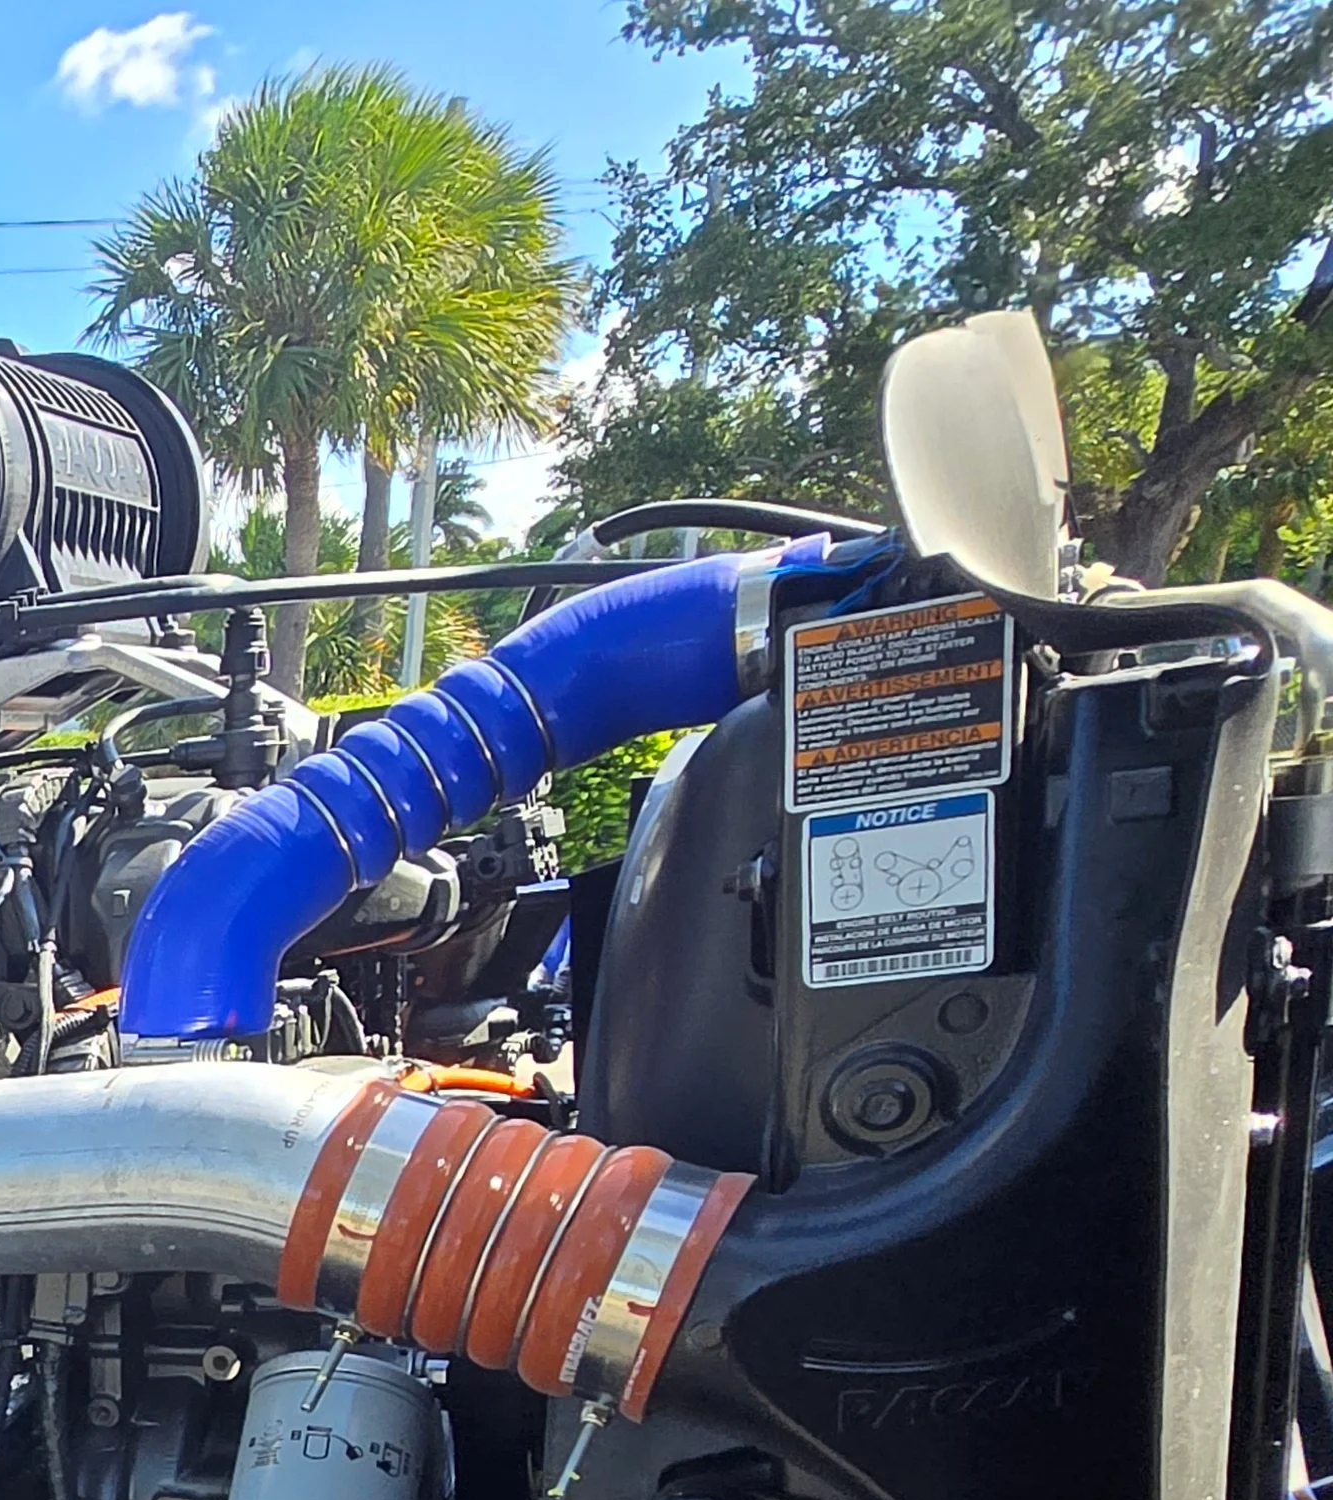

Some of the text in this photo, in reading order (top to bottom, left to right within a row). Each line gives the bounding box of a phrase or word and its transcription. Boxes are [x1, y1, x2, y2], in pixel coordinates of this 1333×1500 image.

[849, 605, 958, 633] WARNING
[817, 663, 995, 702] AVERTISSEMENT
[833, 727, 983, 761] ADVERTENCIA
[855, 803, 937, 830] NOTICE
[282, 1130, 300, 1149] UP
